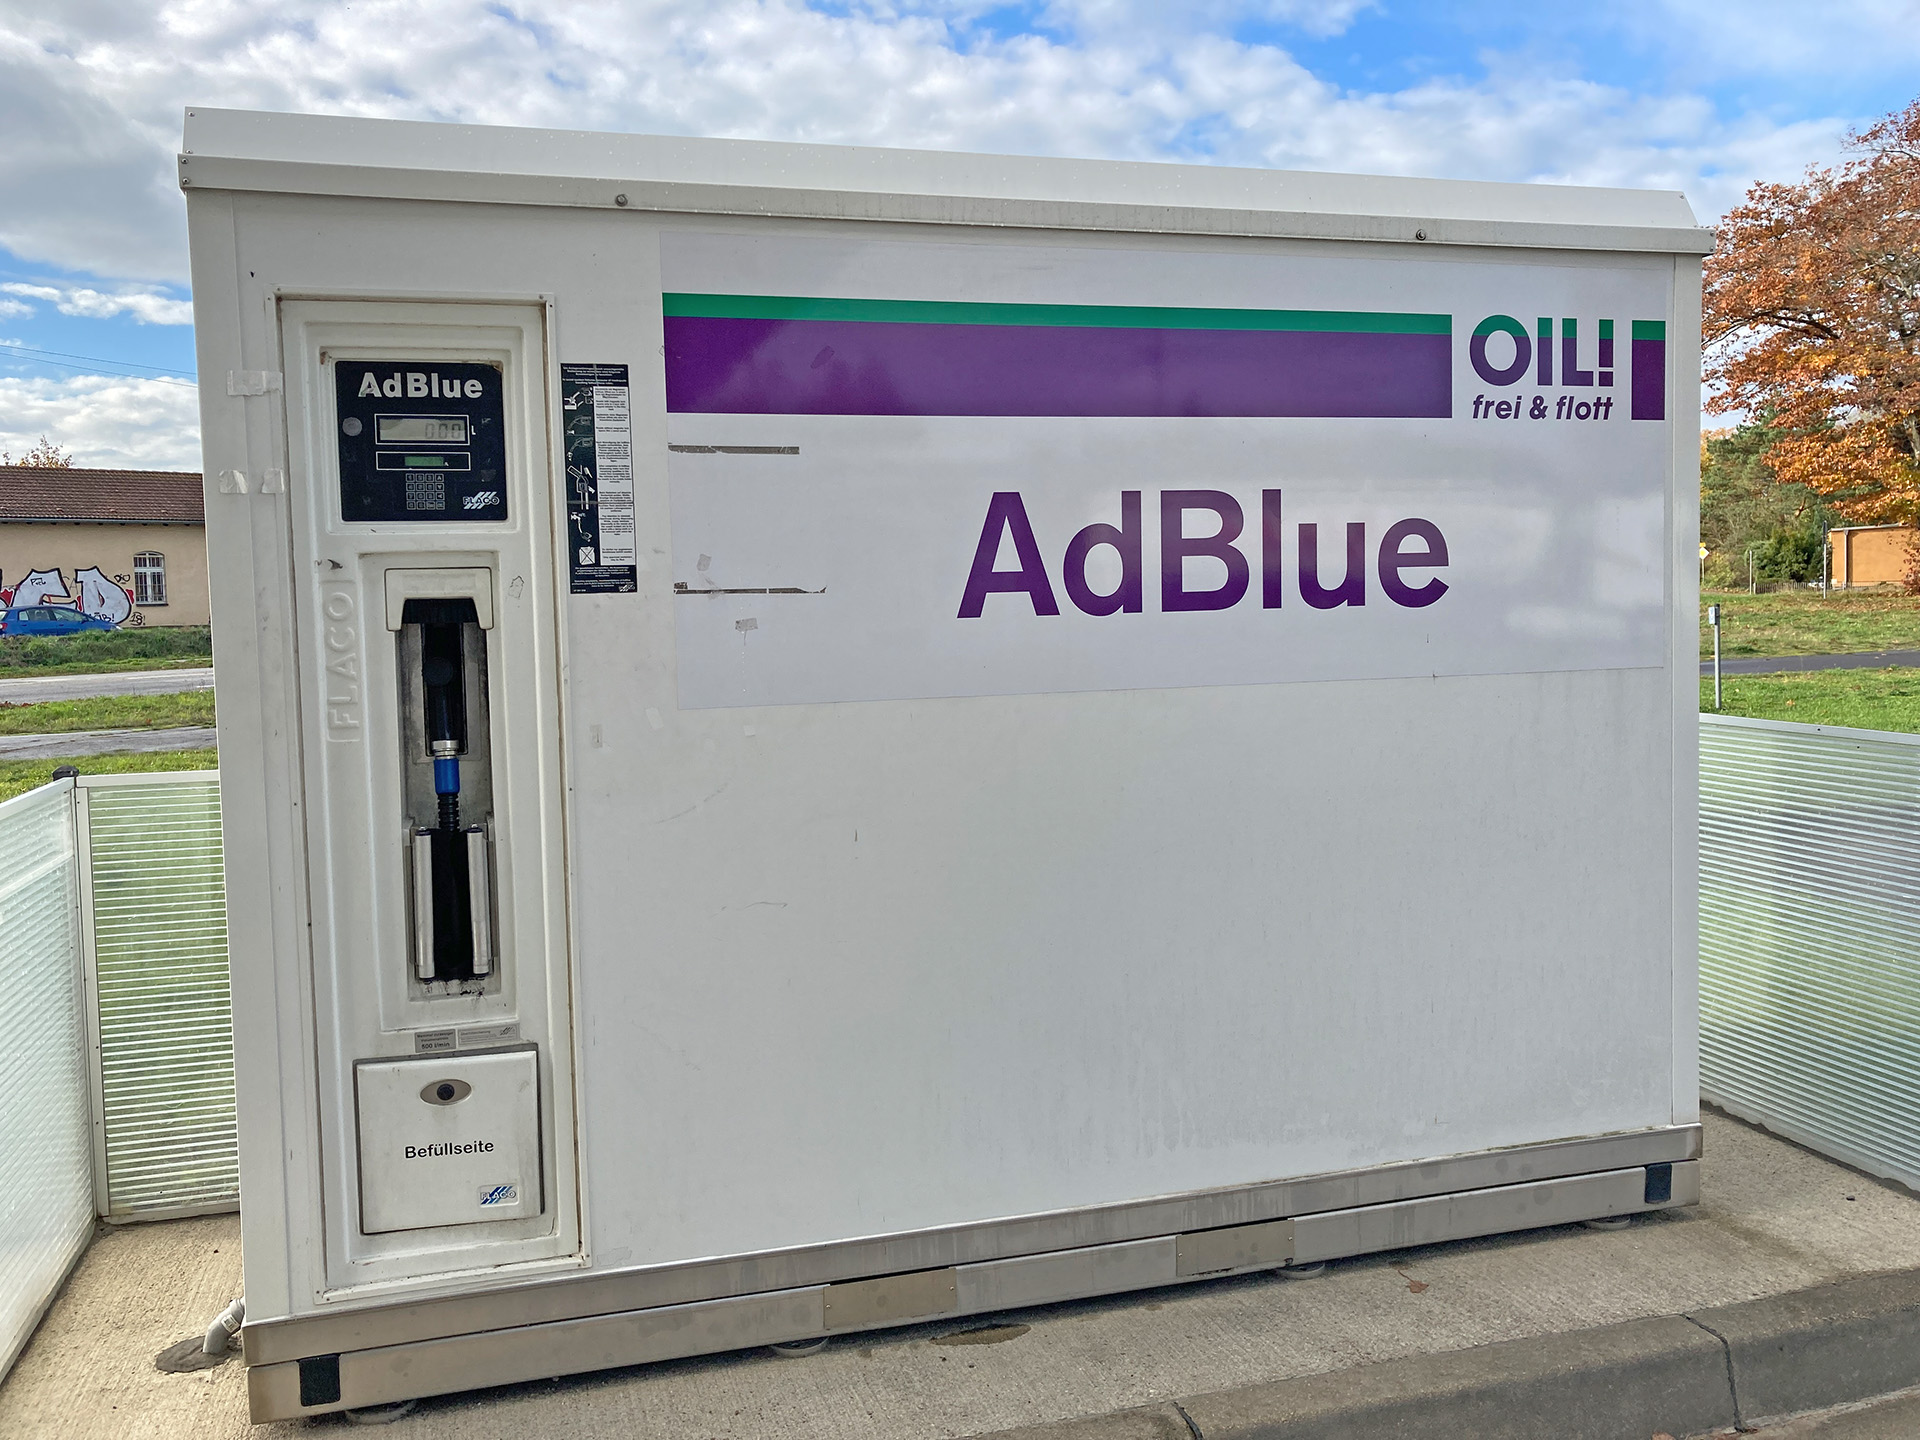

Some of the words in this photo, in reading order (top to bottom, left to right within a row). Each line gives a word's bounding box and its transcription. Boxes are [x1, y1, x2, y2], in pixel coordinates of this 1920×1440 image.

[1469, 314, 1614, 387] OIL!
[358, 372, 483, 399] AdBlue
[1473, 394, 1522, 419] frei
[1529, 395, 1549, 420] &
[1556, 396, 1614, 420] flott
[957, 488, 1450, 618] AdBlue
[325, 591, 360, 729] FLACO
[405, 1140, 495, 1159] Befüllseite
